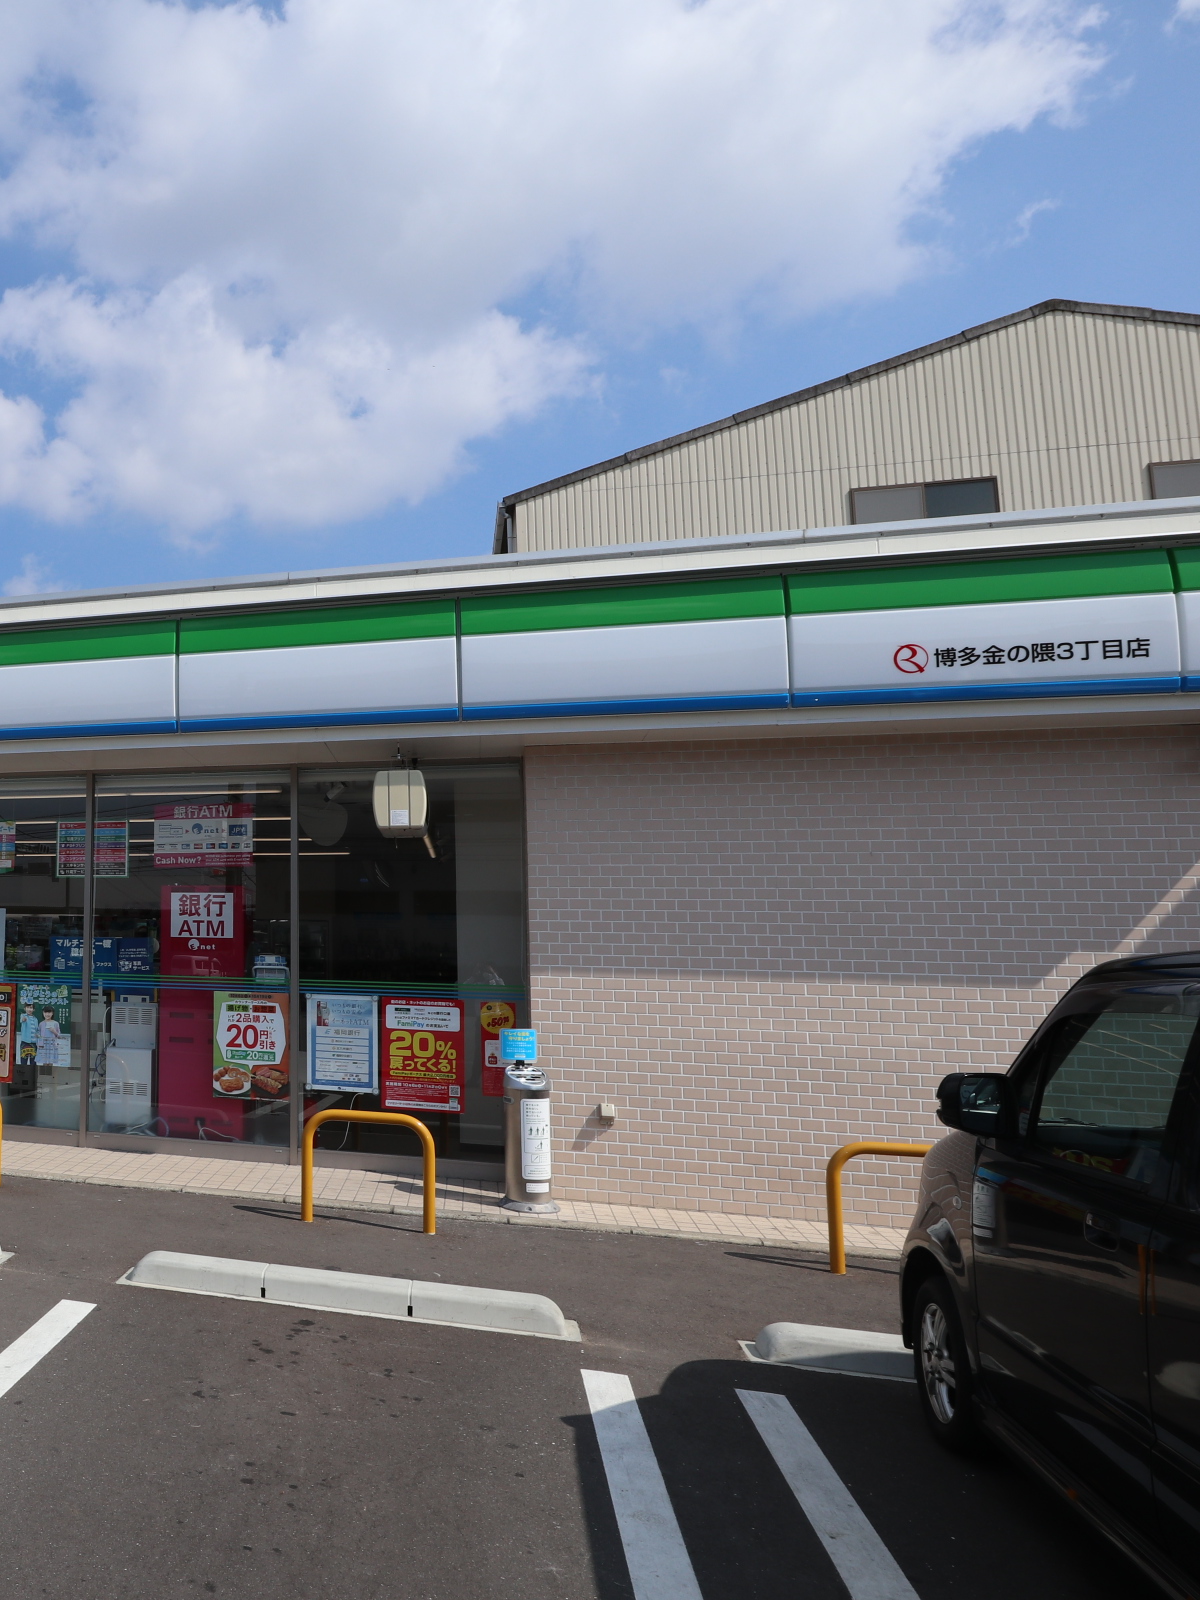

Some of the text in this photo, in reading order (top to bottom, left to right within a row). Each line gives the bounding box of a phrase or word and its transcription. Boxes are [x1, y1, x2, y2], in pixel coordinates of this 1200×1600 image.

[933, 637, 1151, 668] 博多金の隈3丁目店
[173, 804, 233, 819] 銀行ATM
[155, 856, 176, 865] Cash
[178, 856, 202, 865] Now?
[178, 893, 227, 917] 銀行
[178, 920, 225, 937] ATM
[235, 1013, 275, 1024] 2品購入で
[331, 1018, 370, 1026] イーネットATM
[397, 1020, 425, 1029] FamiPay
[226, 1024, 259, 1049] 20
[333, 1028, 361, 1036] 福岡銀行
[259, 1040, 277, 1050] 引き
[389, 1030, 457, 1060] 20%
[389, 1055, 457, 1073] 戻ってくる!
